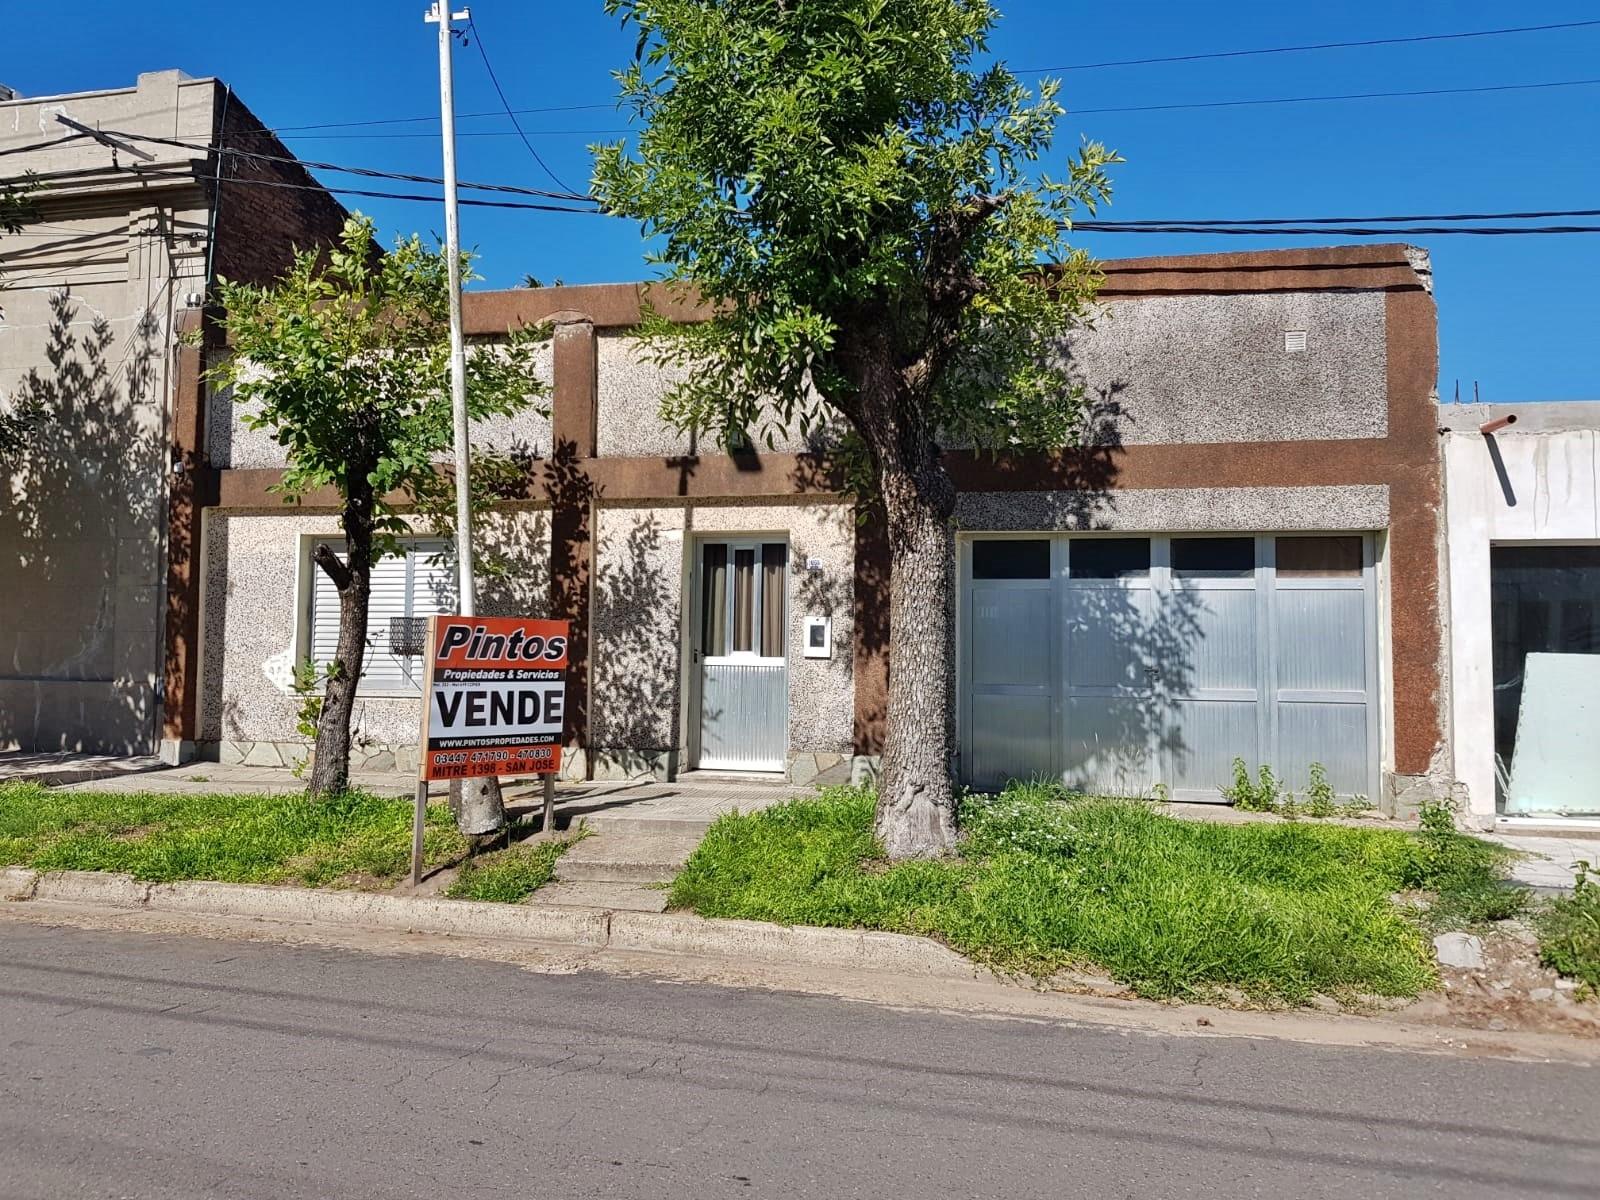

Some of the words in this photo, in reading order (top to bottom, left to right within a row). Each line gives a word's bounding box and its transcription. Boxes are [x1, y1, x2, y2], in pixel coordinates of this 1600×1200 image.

[438, 624, 568, 661] Pintos
[443, 669, 505, 681] Propiedades
[508, 669, 514, 680] &
[516, 669, 560, 680] Servicios
[435, 690, 563, 728] VENDE
[440, 735, 555, 748] WWW.PINTOSPROPIEDADES.COM
[434, 752, 468, 765] 03447
[470, 750, 508, 763] 471790
[517, 748, 552, 760] 470830
[432, 764, 468, 777] MITRE
[471, 763, 496, 775] 1398
[505, 761, 526, 773] SAN
[529, 759, 555, 771] JOSE
